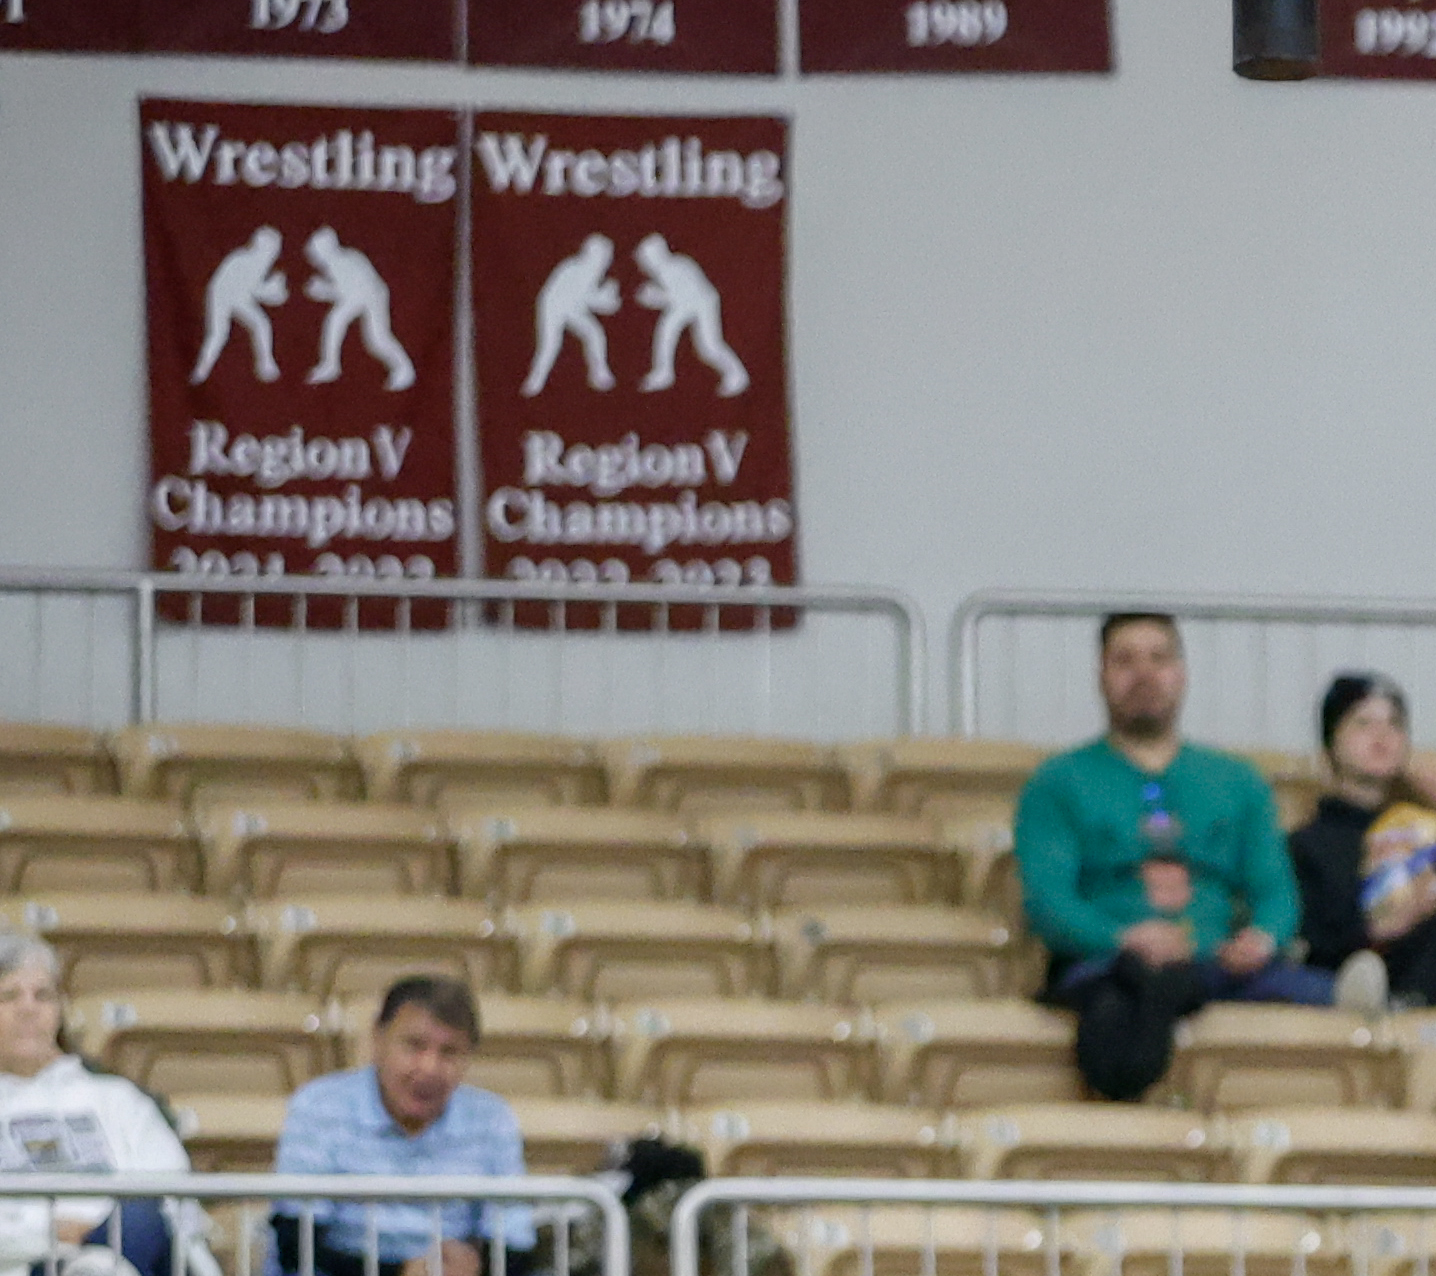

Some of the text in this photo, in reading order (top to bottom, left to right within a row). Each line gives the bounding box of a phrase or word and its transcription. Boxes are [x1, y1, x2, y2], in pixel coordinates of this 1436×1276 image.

[148, 120, 459, 203] Wrestling
[474, 130, 784, 208] Wrestling
[189, 418, 413, 488] Region V
[523, 428, 749, 498] Region V
[153, 474, 456, 549] Champions
[485, 485, 793, 556] Champions
